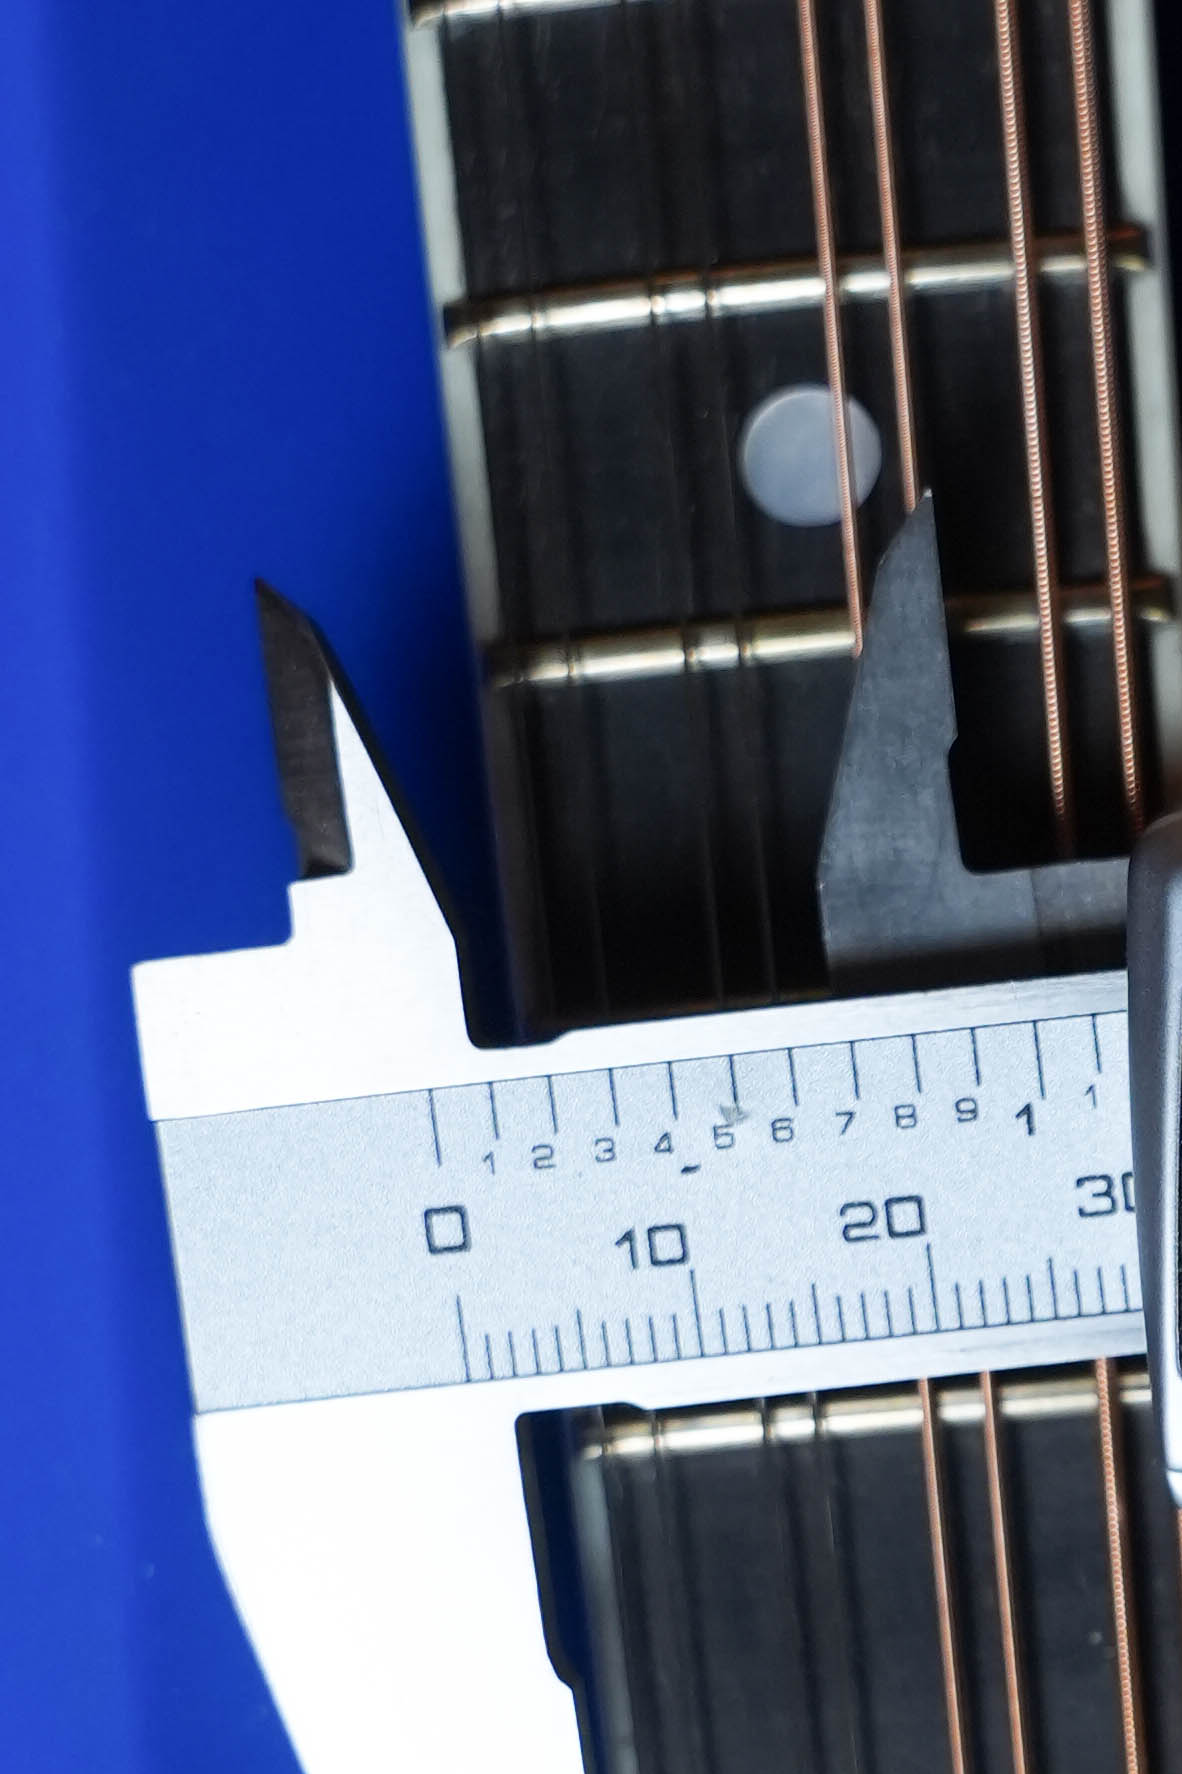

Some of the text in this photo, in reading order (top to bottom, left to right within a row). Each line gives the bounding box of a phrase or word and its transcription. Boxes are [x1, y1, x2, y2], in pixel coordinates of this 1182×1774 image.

[483, 1083, 1098, 1176] 1 2 3 4 5 6 7 8 9 1 1
[423, 1205, 472, 1256] 0
[614, 1222, 692, 1270] 10
[839, 1195, 927, 1243] 20
